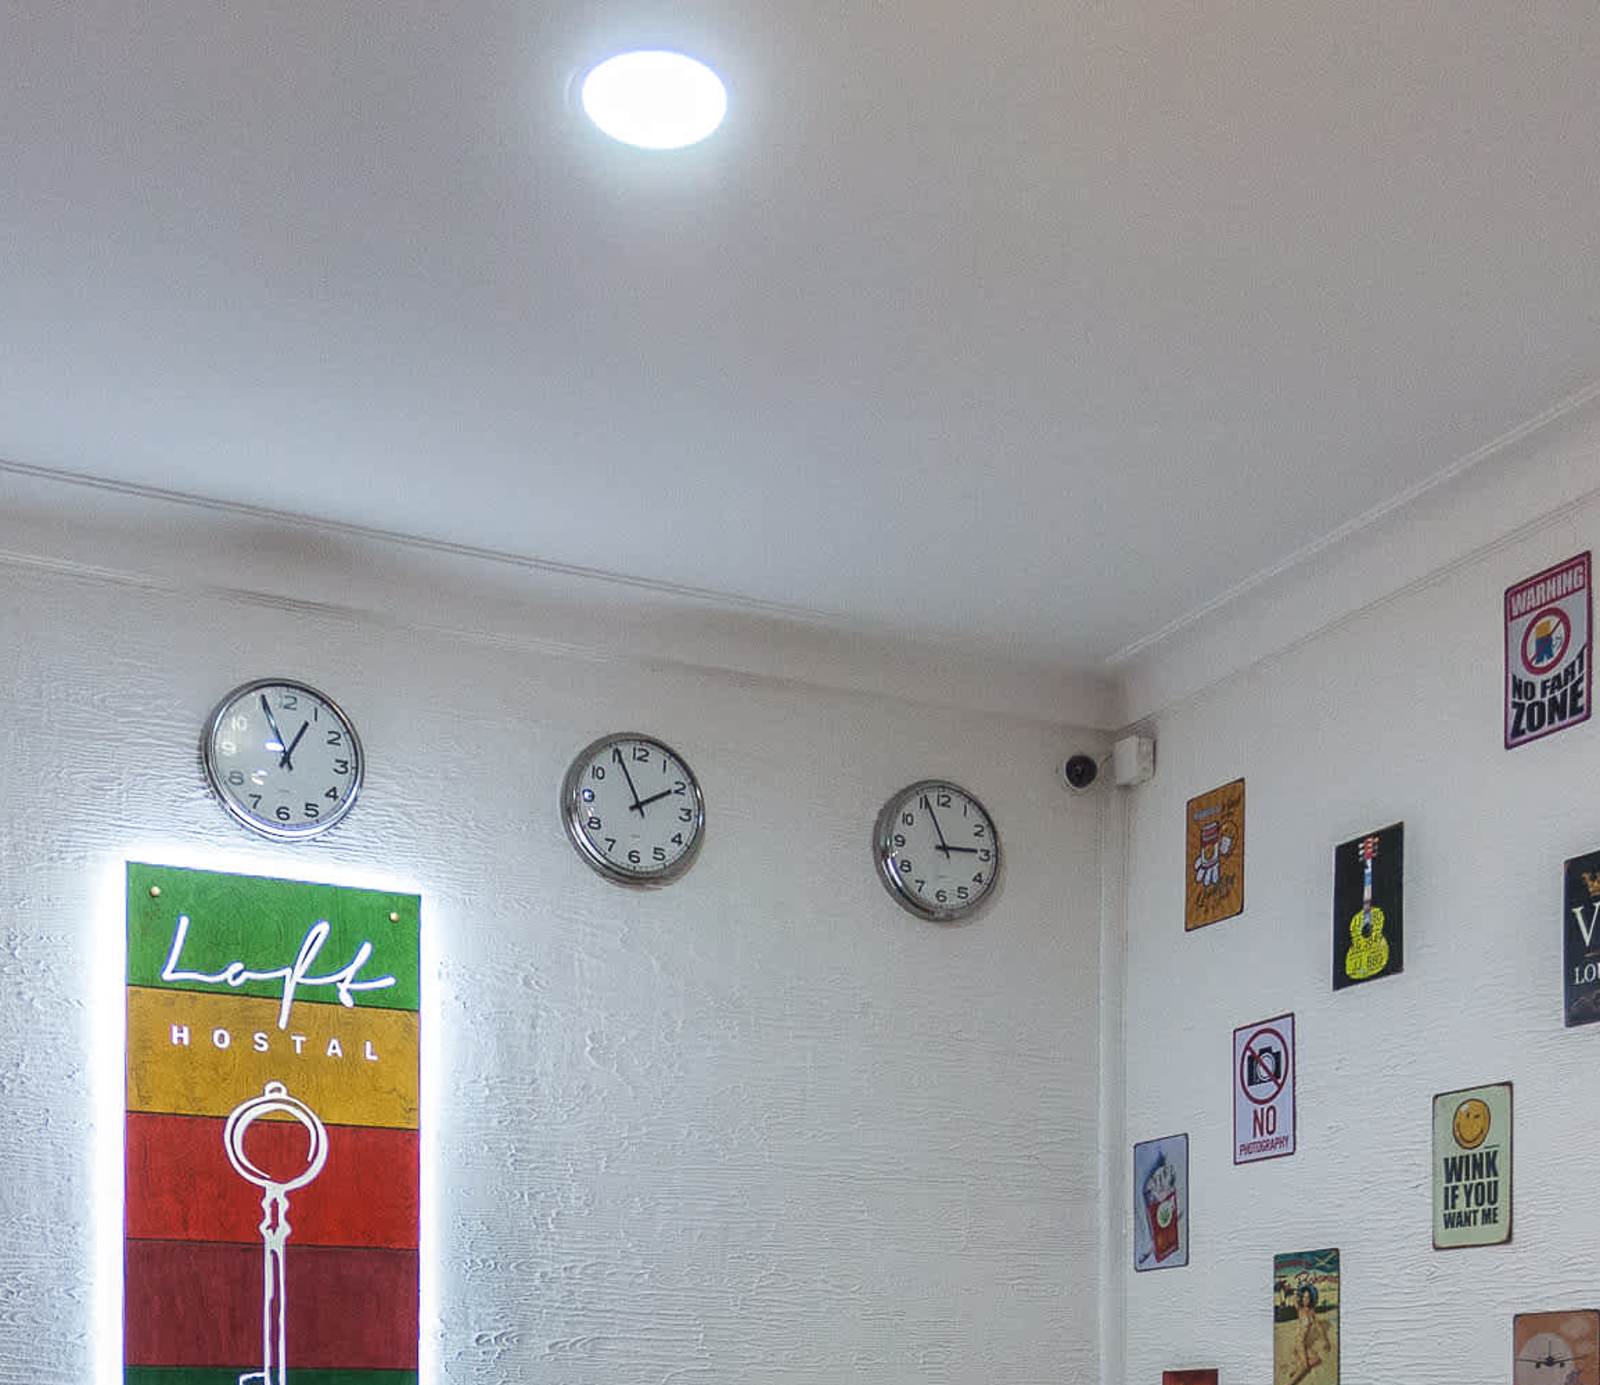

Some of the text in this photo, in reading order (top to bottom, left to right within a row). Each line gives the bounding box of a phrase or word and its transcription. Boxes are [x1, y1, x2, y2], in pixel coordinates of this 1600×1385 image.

[1510, 565, 1585, 615] WARNING
[1512, 644, 1587, 701] NO FART
[280, 695, 297, 711] 2
[1510, 675, 1585, 738] ZONE
[327, 731, 341, 746] 2
[632, 747, 650, 763] 12
[334, 759, 349, 775] 3
[591, 766, 605, 780] 10
[229, 770, 244, 785] 8
[325, 786, 339, 801] 4
[673, 781, 687, 796] 2
[249, 793, 262, 809] 7
[937, 794, 951, 808] 12
[276, 806, 290, 821] 6
[305, 803, 319, 818] 5
[678, 808, 692, 822] 3
[587, 816, 601, 830] 8
[902, 813, 914, 826] 10
[973, 824, 985, 837] 2
[605, 837, 617, 852] 7
[671, 832, 683, 846] 4
[894, 834, 906, 847] 9
[628, 850, 640, 863] 6
[652, 847, 666, 861] 5
[978, 850, 991, 862] 3
[900, 860, 912, 873] 8
[972, 872, 983, 884] 4
[915, 879, 926, 893] 7
[957, 886, 969, 899] 5
[935, 890, 947, 902] 6
[162, 914, 396, 1030] Loft
[171, 1024, 378, 1061] HOSTAL
[1253, 1105, 1277, 1138] NO
[1239, 1135, 1289, 1156] PHOTOGRAPHY
[1443, 1150, 1499, 1184] WINK
[1444, 1180, 1499, 1211] IF YOU
[1443, 1207, 1499, 1229] WANT ME
